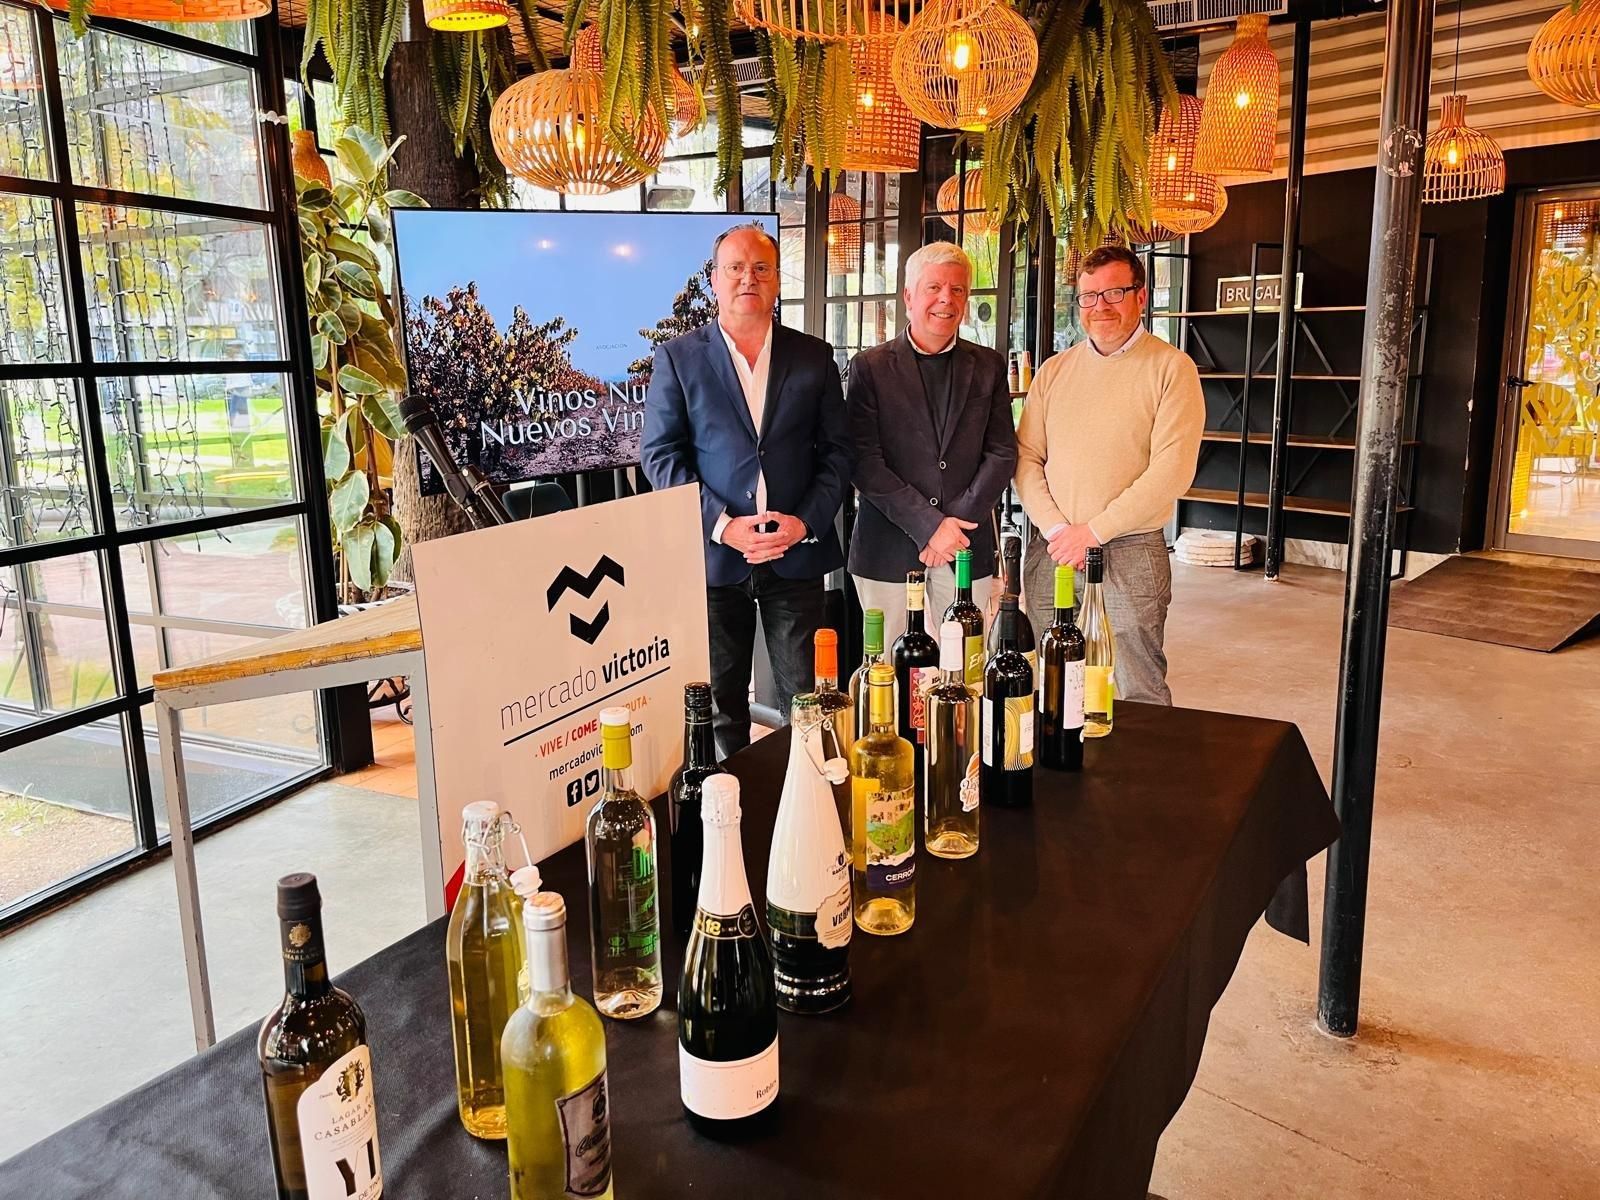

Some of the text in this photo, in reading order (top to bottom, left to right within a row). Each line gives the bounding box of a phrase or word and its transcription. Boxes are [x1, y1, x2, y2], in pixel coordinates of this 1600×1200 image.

[1226, 285, 1281, 302] BRUGAL
[514, 380, 646, 415] Vinos Nu
[480, 406, 644, 450] Nuevos Vin
[501, 636, 670, 730] mercado victoria
[540, 736, 563, 757] VIVE
[571, 719, 598, 742] COME
[314, 1099, 374, 1142] CASABLAN
[331, 1105, 362, 1125] LAGAR
